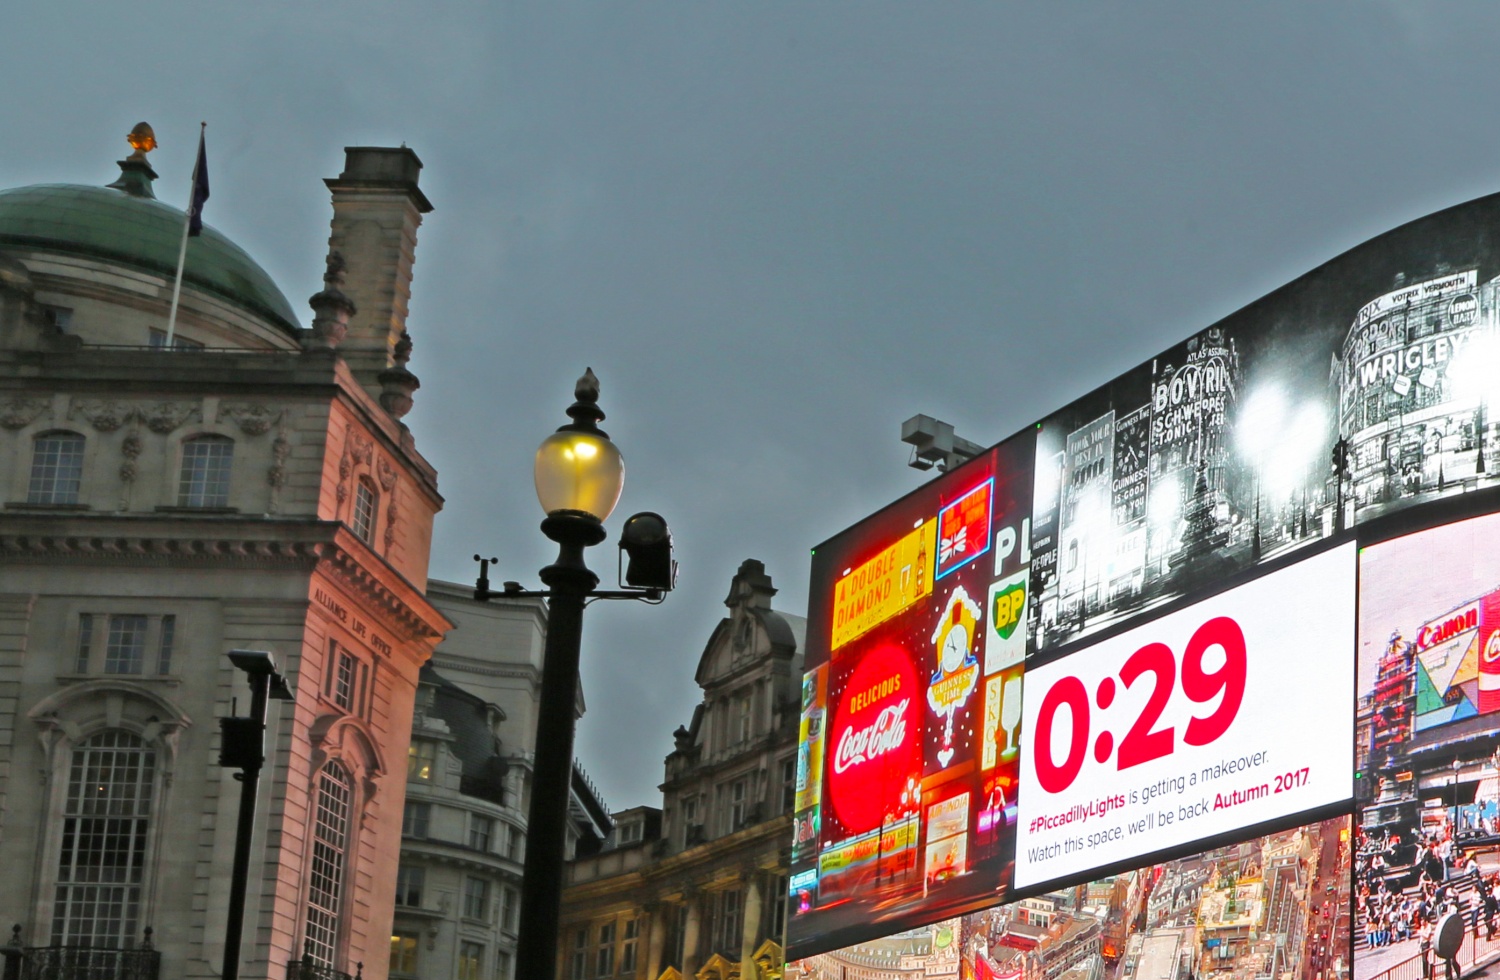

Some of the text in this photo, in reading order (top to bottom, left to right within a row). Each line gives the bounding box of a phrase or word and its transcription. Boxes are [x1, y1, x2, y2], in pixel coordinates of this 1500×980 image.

[1391, 289, 1420, 303] VOTRIX
[1424, 277, 1466, 294] VERMOUTH
[1186, 348, 1207, 363] ATLAS
[1155, 366, 1226, 413] BOVRIL
[1115, 415, 1139, 433] GUINNESS
[1112, 466, 1148, 493] GUINNESS
[1124, 483, 1145, 500] GOOD
[1129, 496, 1145, 508] YOU
[839, 548, 896, 604] A DOUBLE
[1031, 548, 1058, 573] PEOPLE
[315, 588, 393, 659] ALLIANCE LIFE OFFICE
[836, 577, 892, 629] DIAMOND
[995, 588, 1025, 630] BP
[1417, 608, 1477, 649] Canon
[850, 674, 901, 714] DELICIOUS
[934, 671, 973, 696] GUINNESS
[942, 687, 962, 703] TIME
[986, 682, 1000, 766] SKOL
[1033, 616, 1247, 794] 0:29
[834, 698, 910, 774] Coca-Cola
[1029, 750, 1270, 835] #PiccadillyLights is getting a makeover.
[1028, 766, 1311, 864] Watch this space, we'll be back Autumn 2017.
